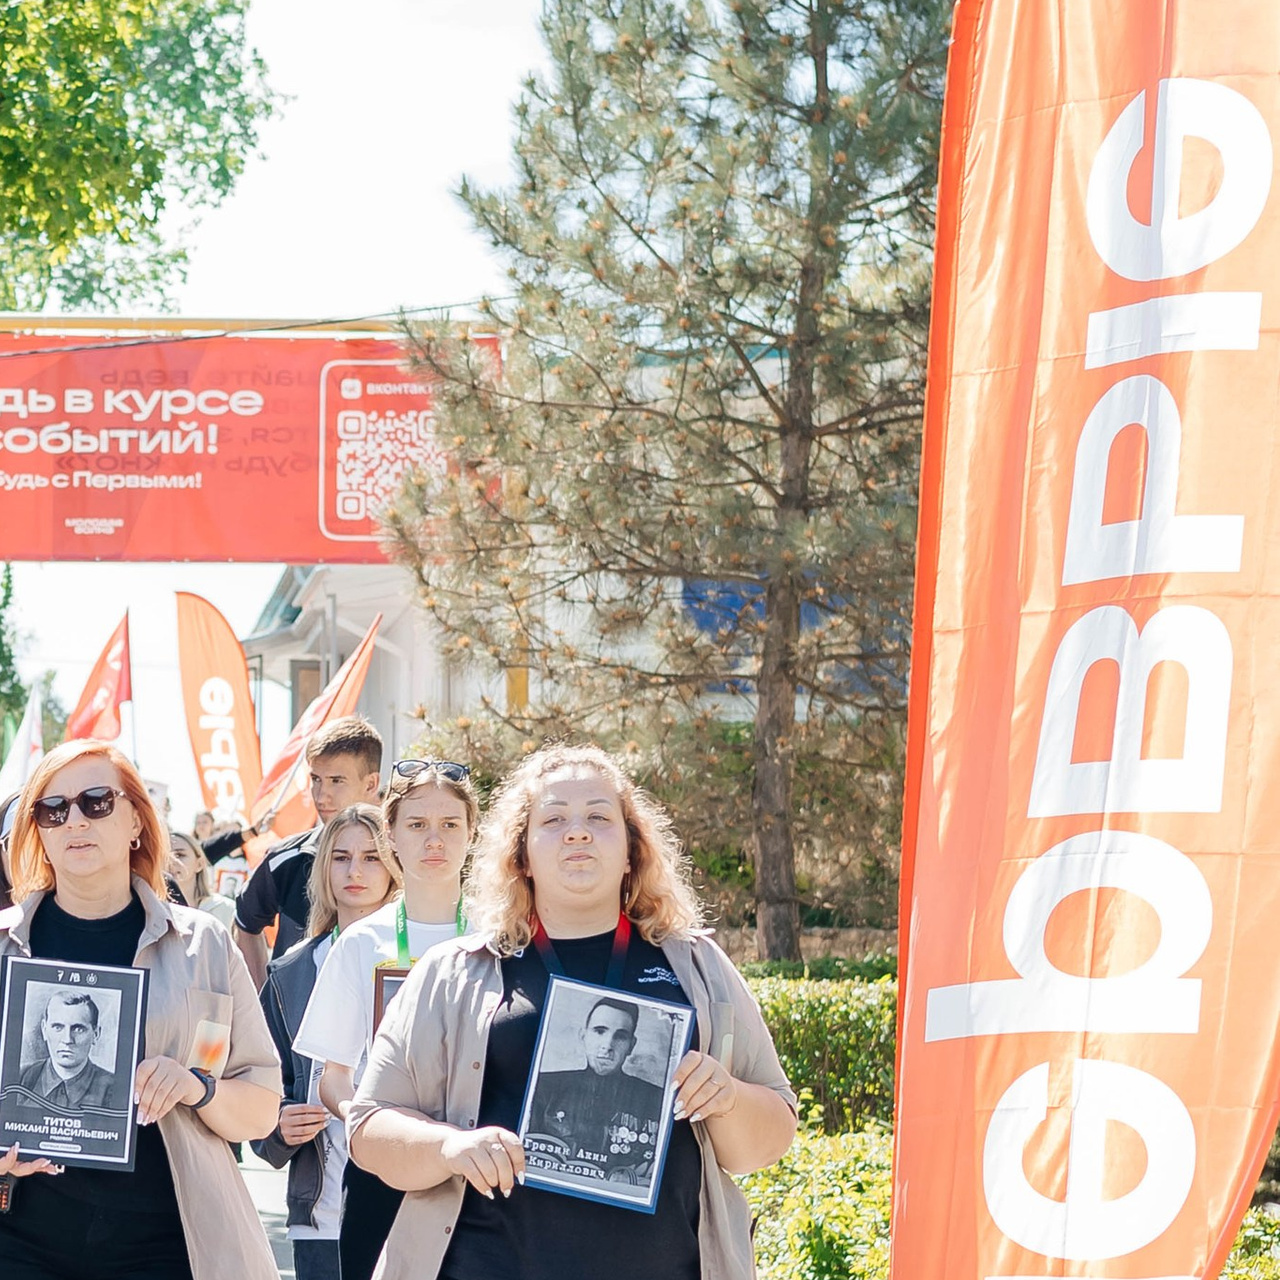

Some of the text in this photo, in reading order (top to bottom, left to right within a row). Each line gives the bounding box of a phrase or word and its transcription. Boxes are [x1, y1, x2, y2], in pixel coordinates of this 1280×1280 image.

[64, 388, 95, 414] в
[104, 387, 264, 422] курсе
[51, 475, 70, 488] с
[72, 470, 203, 492] Первыми!
[4, 1121, 119, 1141] МИХАИЛ ВАСИЛЬЕВИЧ
[43, 1116, 82, 1129] ТИТОВ
[528, 1155, 606, 1179] Кириллович
